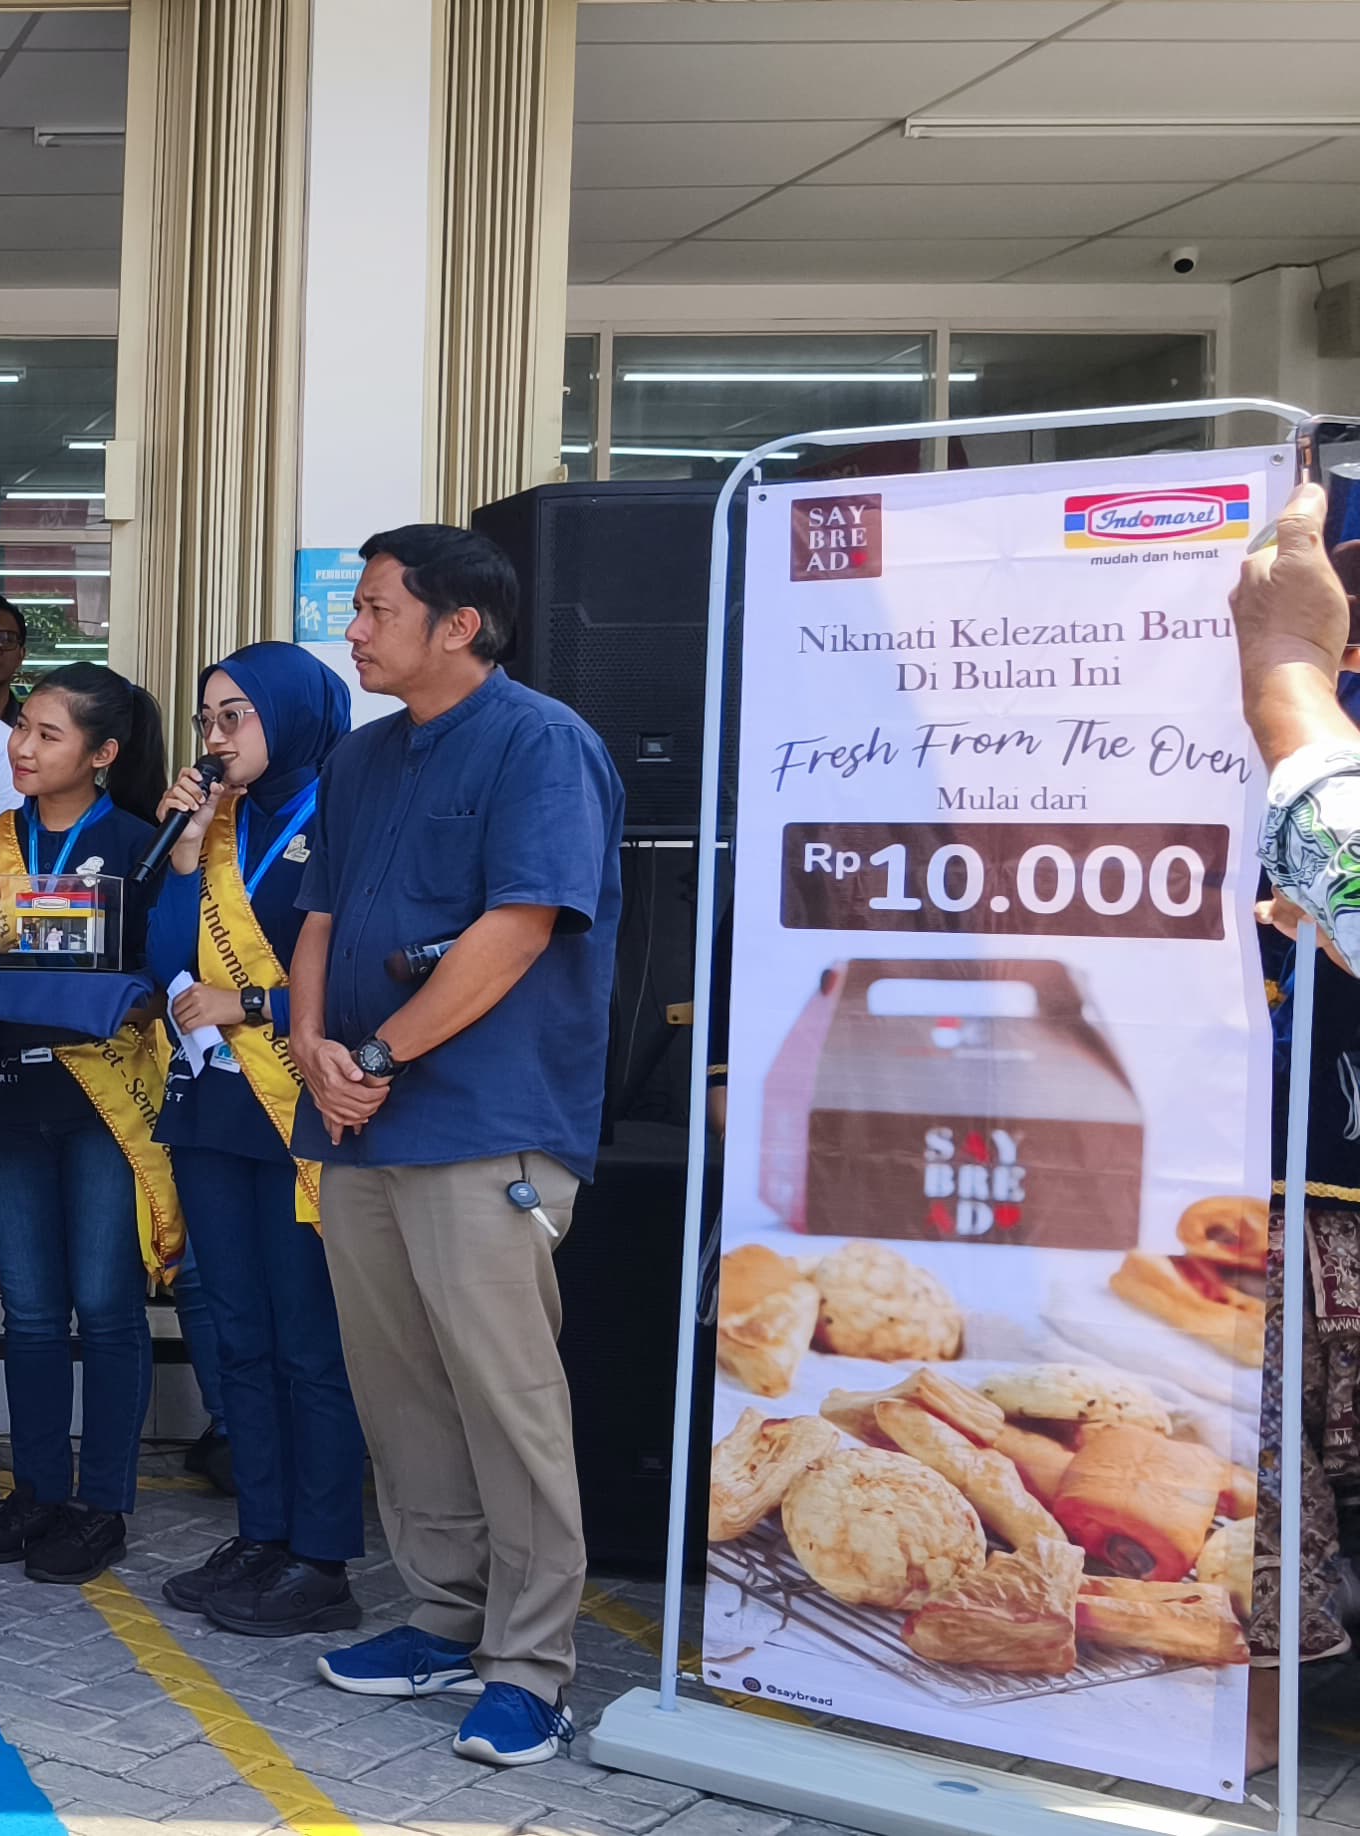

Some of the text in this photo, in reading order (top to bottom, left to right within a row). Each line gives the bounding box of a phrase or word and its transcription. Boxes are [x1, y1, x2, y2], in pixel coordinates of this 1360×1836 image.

[809, 504, 868, 528] SAY
[1095, 504, 1216, 534] Indomaret
[808, 527, 868, 550] BRE
[806, 551, 849, 574] AD
[1090, 547, 1220, 566] mudah dan hemat
[797, 609, 1231, 655] Nikmati Kelezatan Baru
[896, 656, 1122, 693] Di Bulan Ini
[771, 718, 1253, 792] Fresh From The Oven
[936, 785, 1088, 811] Mulai dari
[766, 1684, 833, 1706] @saybread
